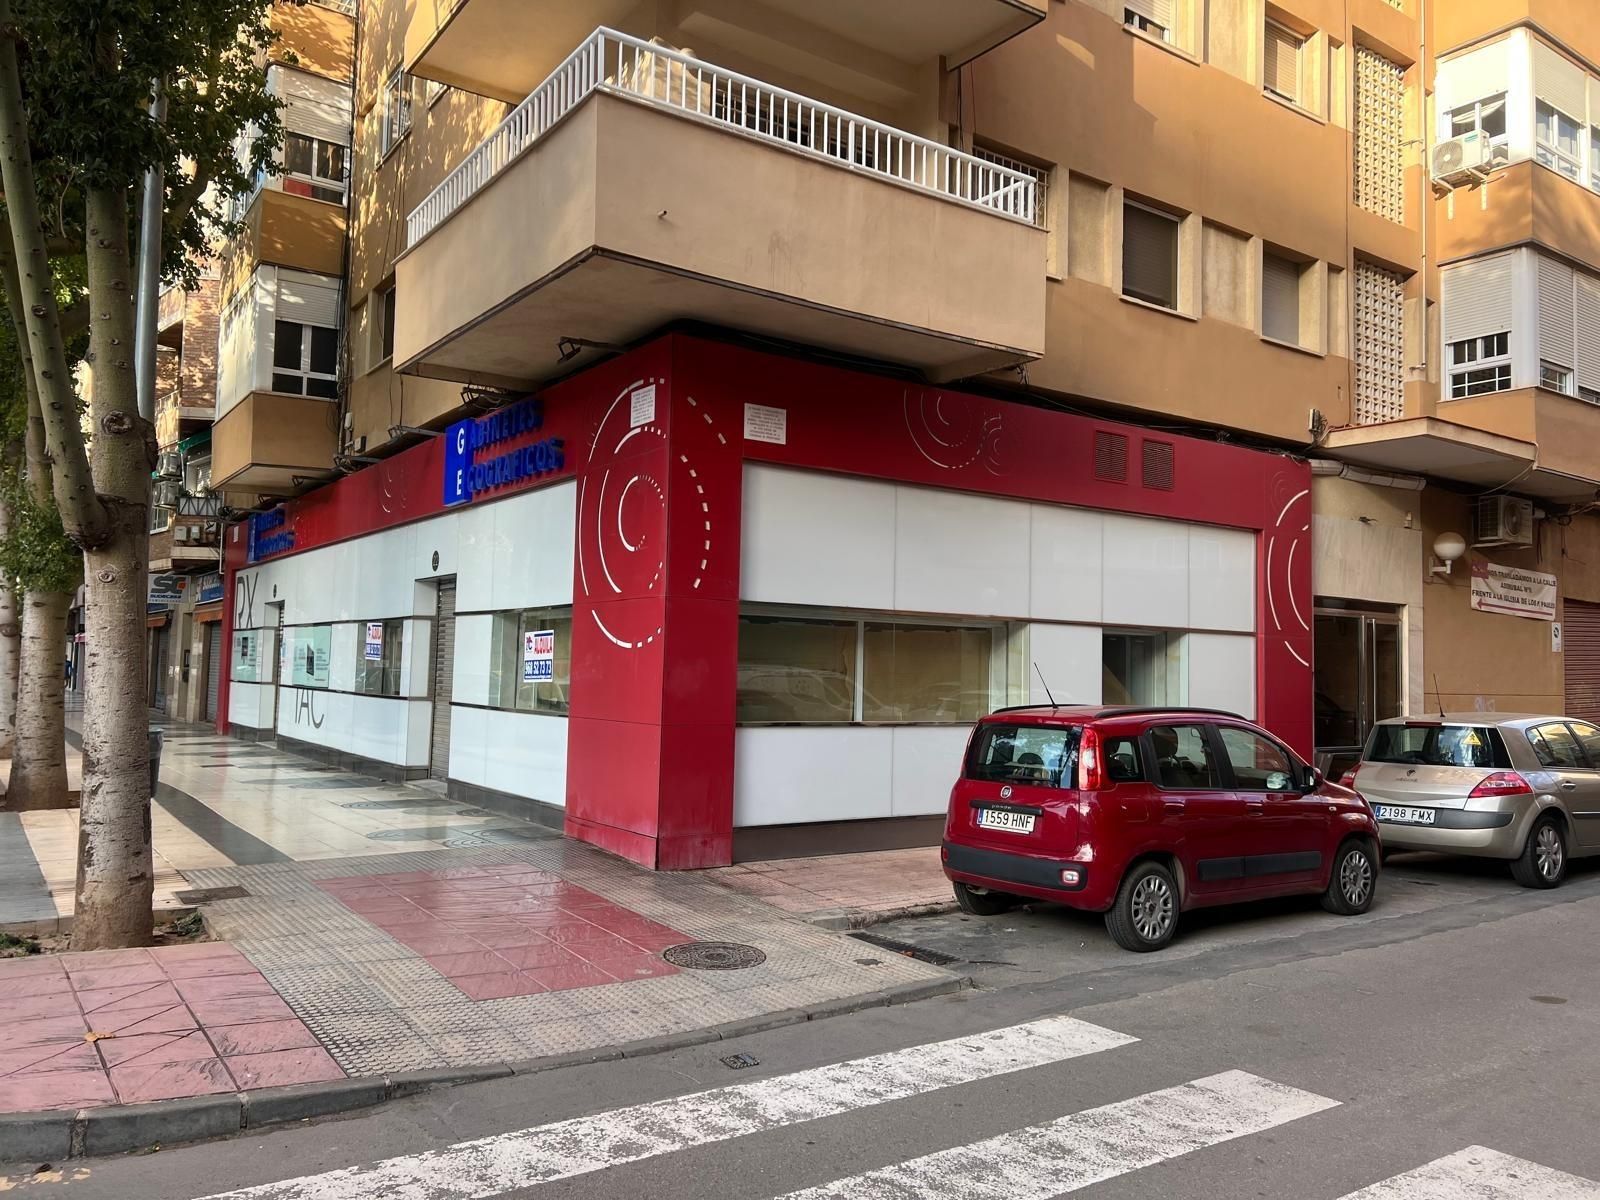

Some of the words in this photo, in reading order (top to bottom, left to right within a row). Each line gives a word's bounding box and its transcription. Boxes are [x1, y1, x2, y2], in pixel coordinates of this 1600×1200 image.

[234, 572, 259, 628] RX
[1472, 590, 1491, 598] FRENTE
[986, 811, 1009, 825] 1559
[1012, 813, 1032, 828] HNF
[1381, 807, 1406, 818] 2198
[1411, 809, 1433, 821] FMX
